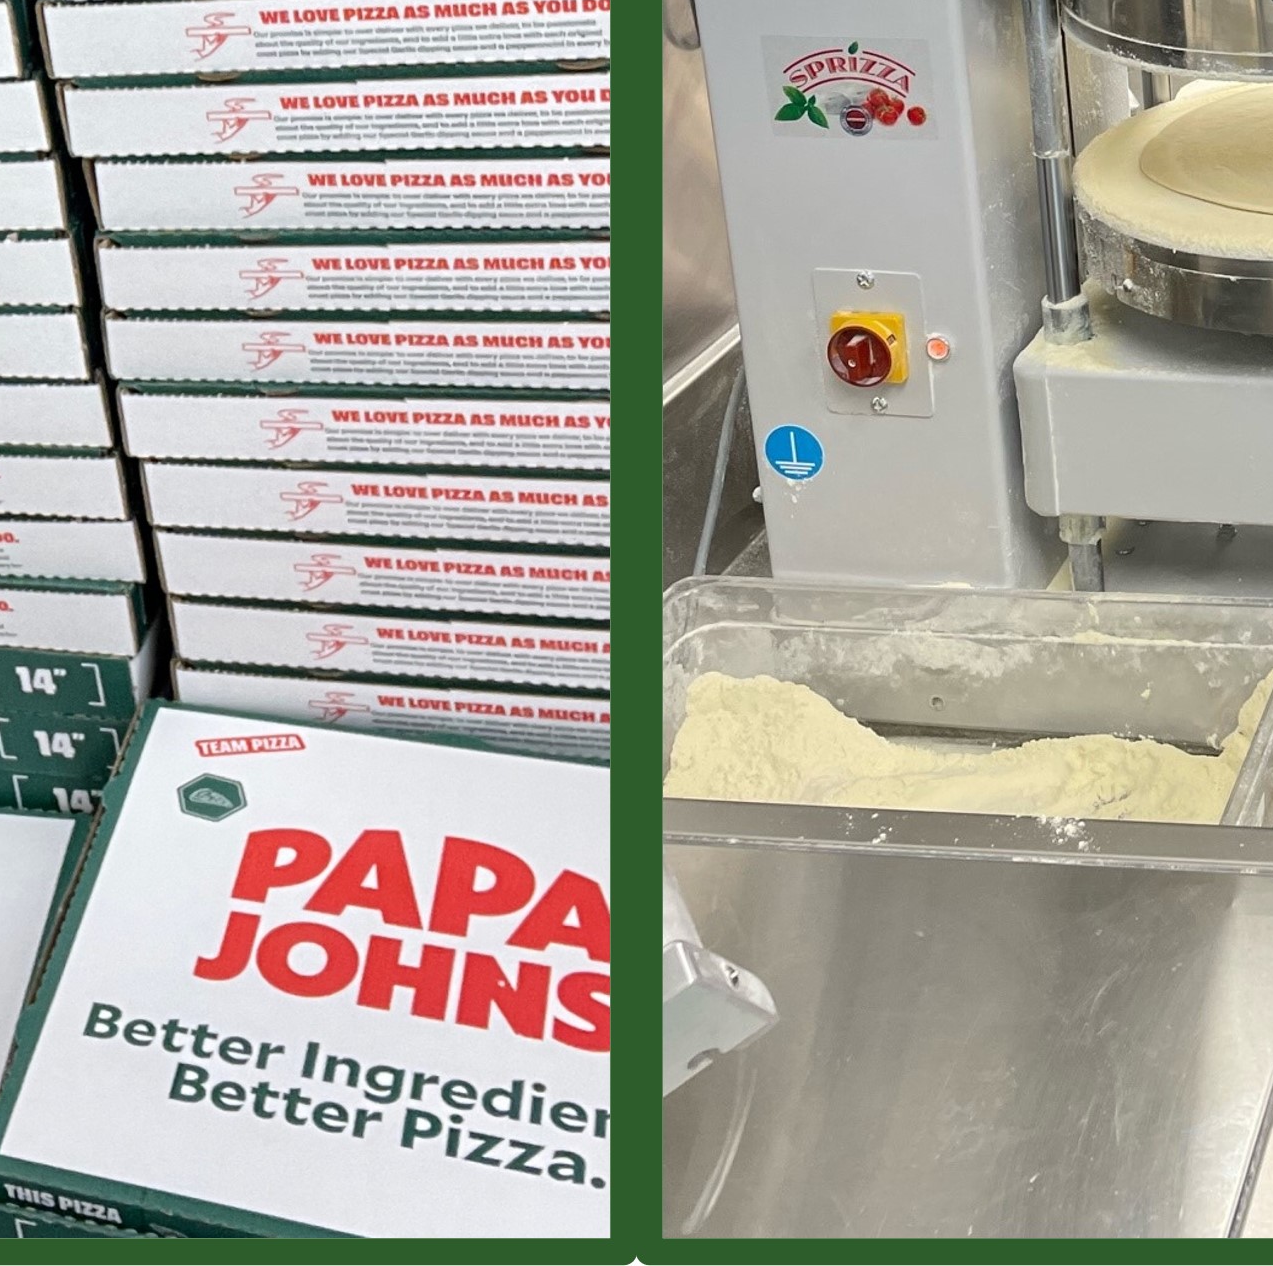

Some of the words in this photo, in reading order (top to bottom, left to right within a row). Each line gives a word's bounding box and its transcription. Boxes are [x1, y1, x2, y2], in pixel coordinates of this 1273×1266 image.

[259, 9, 289, 24] WE
[293, 8, 339, 23] LOVE
[342, 6, 399, 21] PIZZA
[402, 5, 430, 19] AS
[433, 2, 497, 18] MUCH
[501, 0, 529, 15] AS
[533, 0, 577, 14] YOU
[788, 55, 910, 95] SPRIZZA
[16, 667, 66, 694] 14"
[34, 731, 84, 758] 14"
[199, 739, 249, 755] TEAM
[251, 736, 301, 752] PIZZA
[230, 828, 610, 965] PAPA
[83, 1001, 286, 1071] Better
[168, 1062, 383, 1140] Better
[400, 1107, 606, 1189] Pizza.
[3, 1183, 56, 1208] THIS
[58, 1195, 123, 1225] PIZZA
